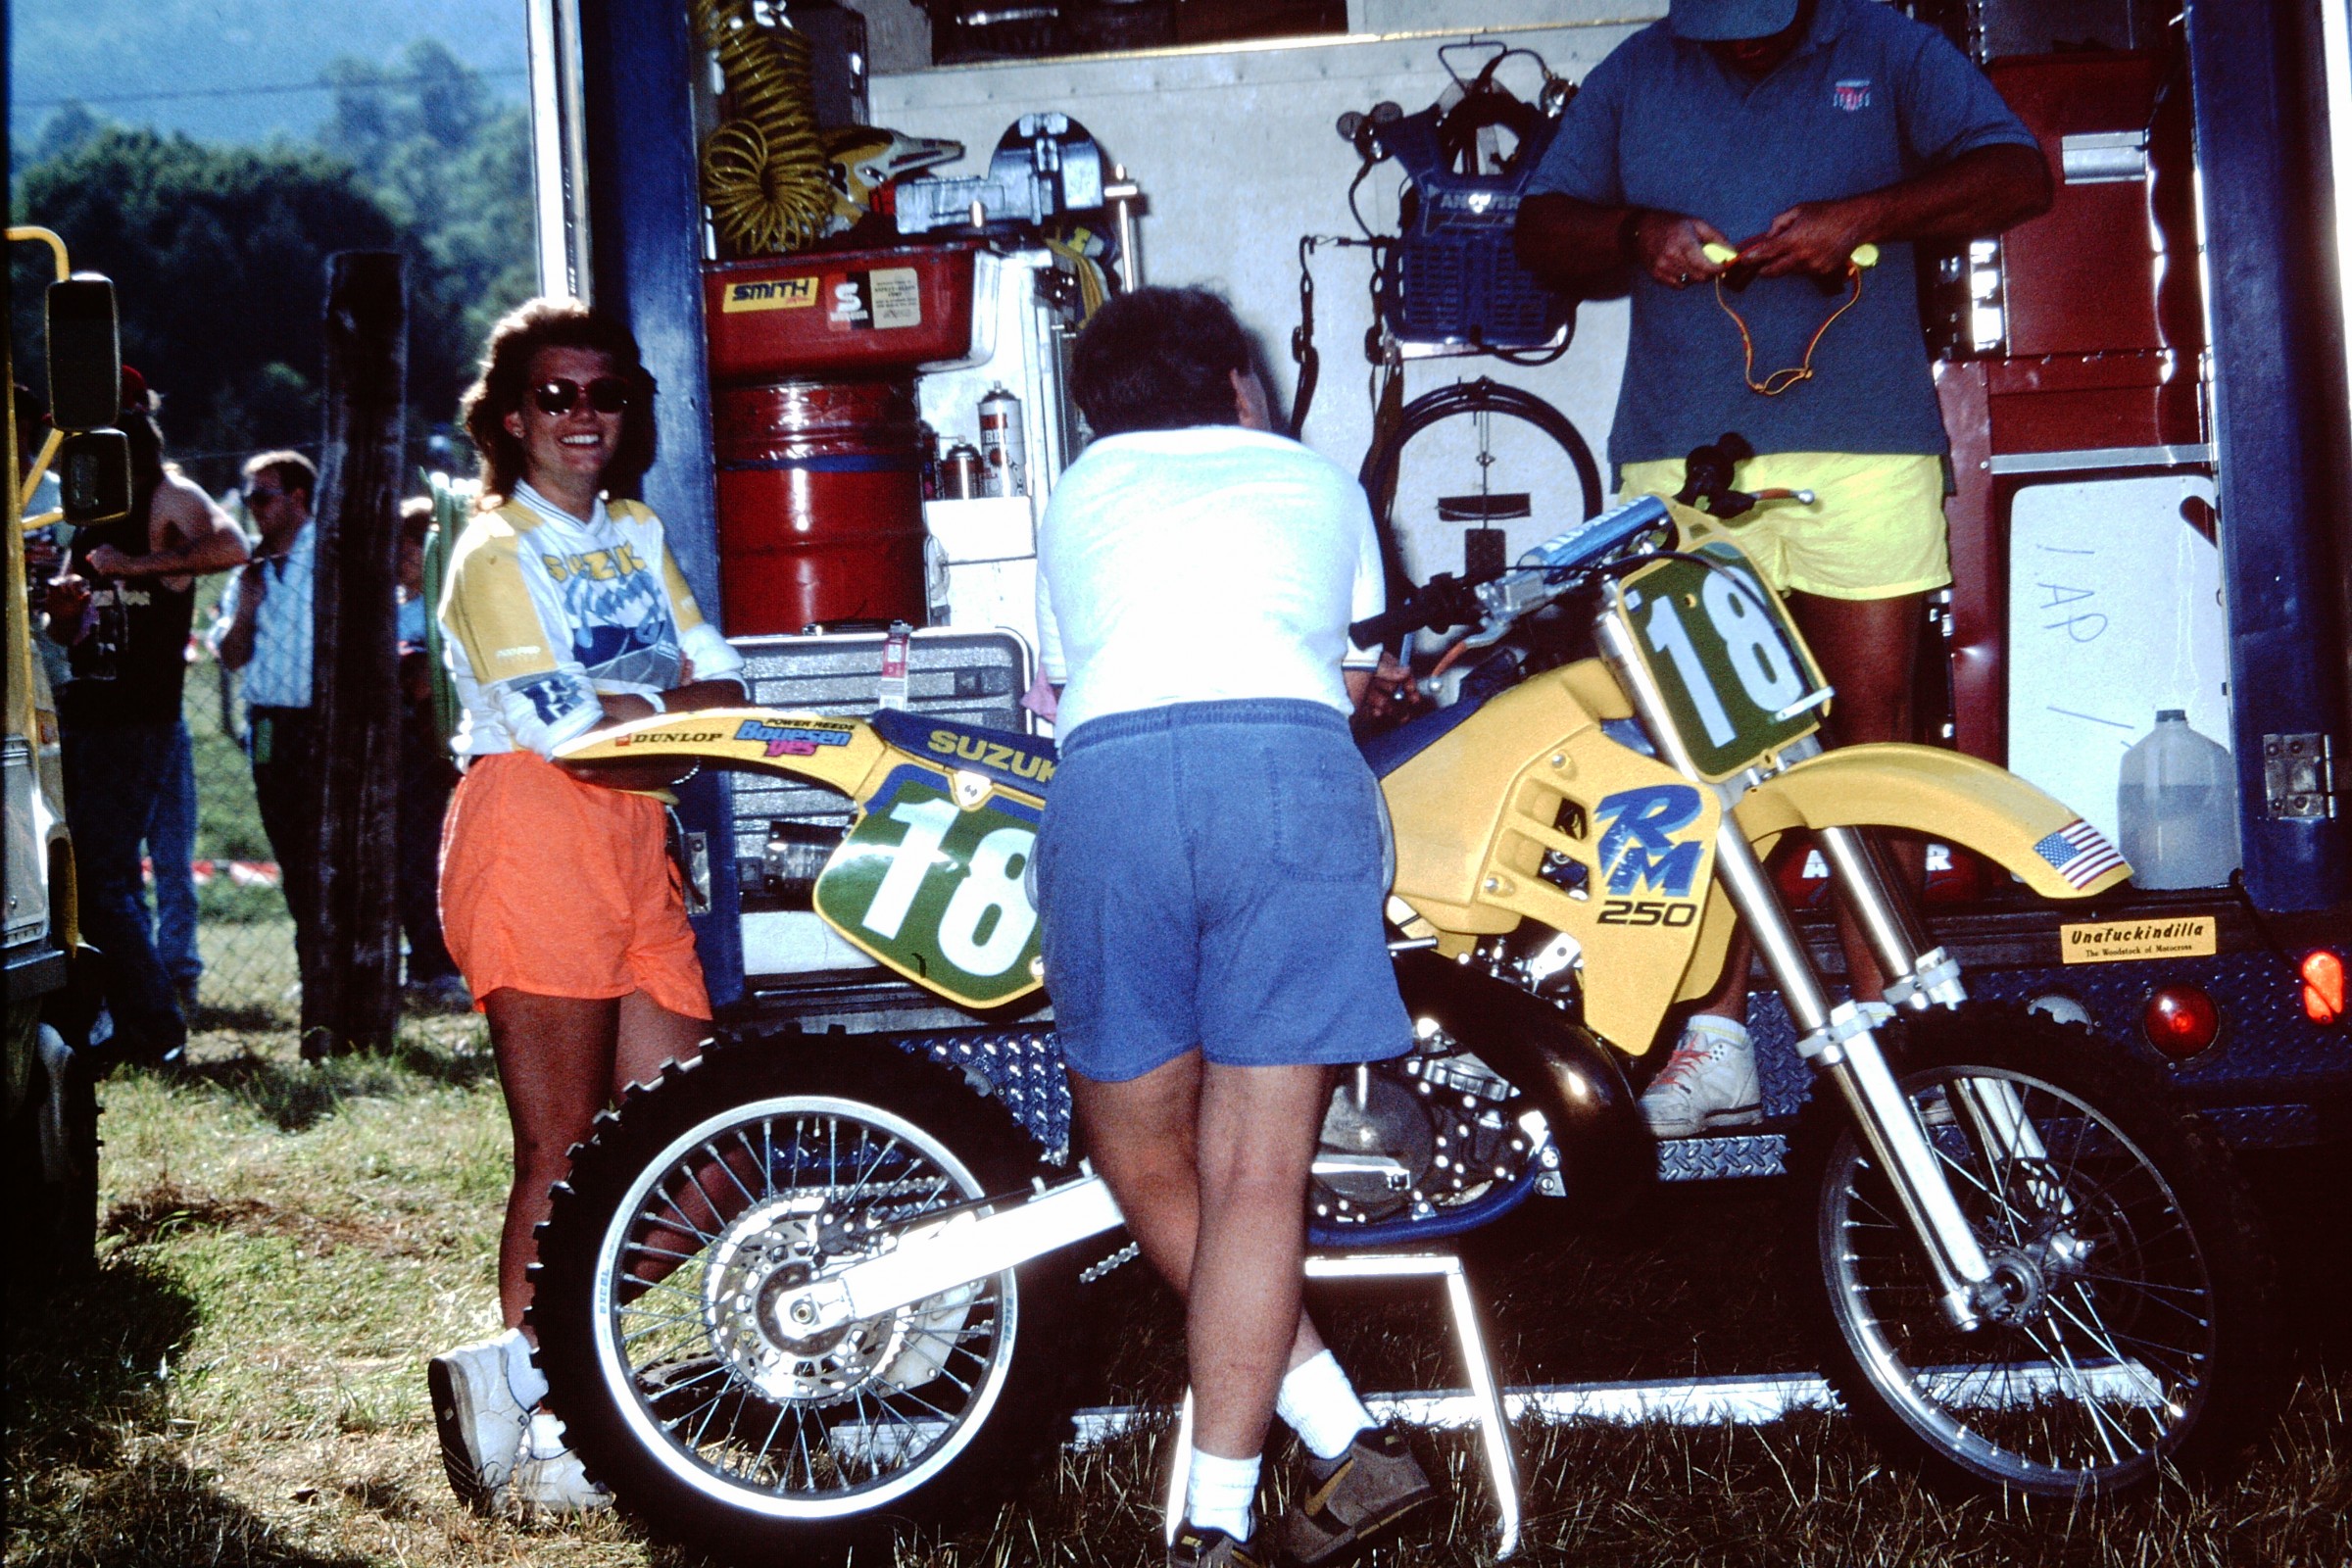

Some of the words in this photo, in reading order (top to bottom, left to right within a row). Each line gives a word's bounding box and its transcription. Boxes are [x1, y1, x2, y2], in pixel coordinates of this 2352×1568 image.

[732, 279, 809, 302] SMITH
[1645, 565, 1805, 748] 18
[765, 717, 811, 727] POWER
[812, 720, 856, 731] REEDS
[632, 732, 723, 744] DUNLOP
[861, 797, 1038, 976] 18
[1596, 900, 1698, 927] 250
[2071, 922, 2204, 945] Unafuckindilla
[2085, 949, 2099, 957] The
[2102, 947, 2141, 956] Woodstock
[2156, 944, 2192, 953] Motocross
